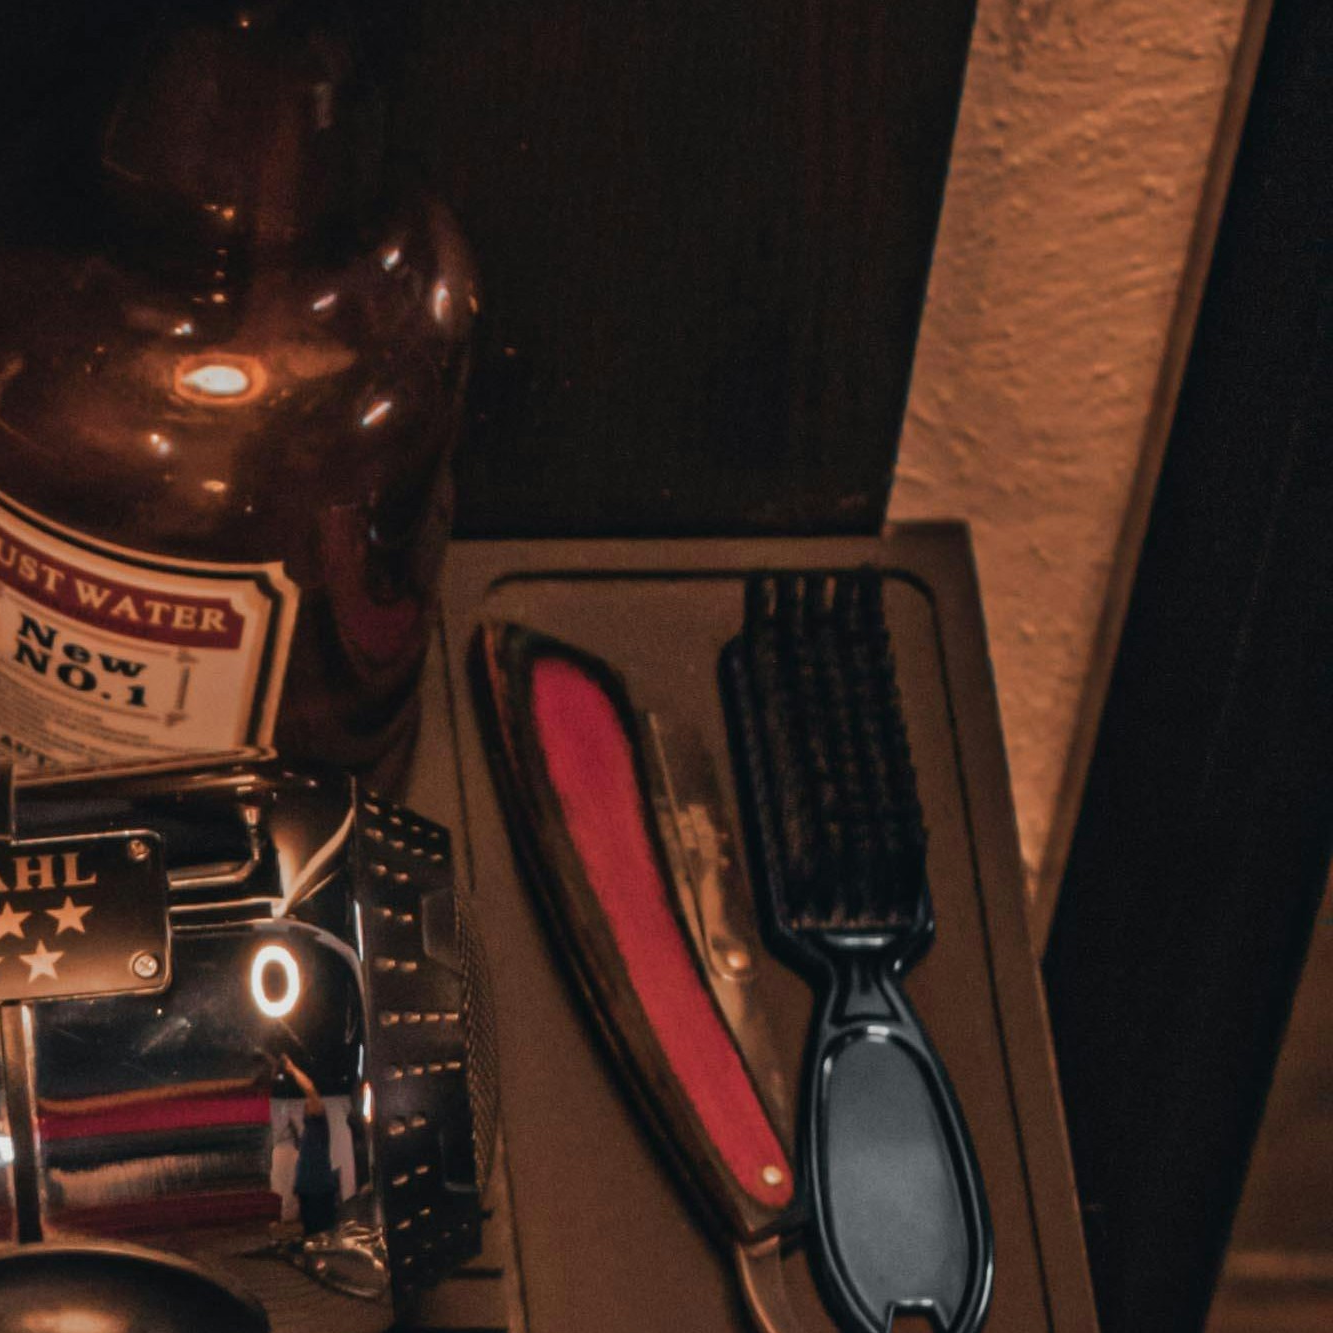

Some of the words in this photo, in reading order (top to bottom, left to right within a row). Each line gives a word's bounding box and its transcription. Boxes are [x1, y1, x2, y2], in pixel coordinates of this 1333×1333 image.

[72, 577, 229, 634] WATER
[13, 643, 150, 708] NO.1
[16, 612, 148, 679] New
